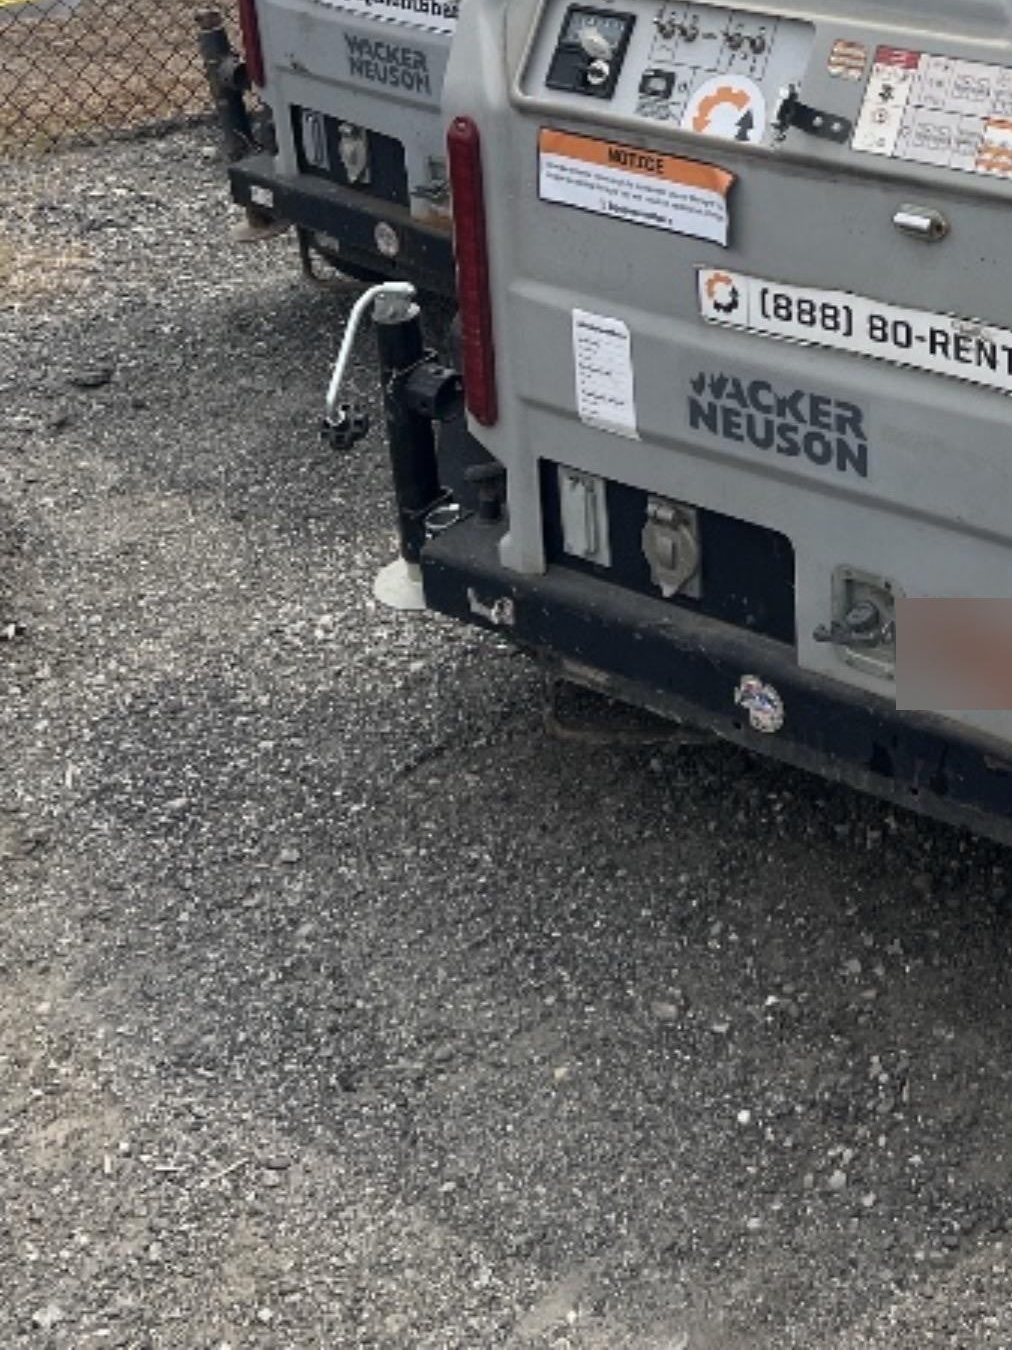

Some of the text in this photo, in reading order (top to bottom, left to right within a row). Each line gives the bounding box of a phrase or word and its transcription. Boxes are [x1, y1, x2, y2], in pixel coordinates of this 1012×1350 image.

[344, 33, 429, 73] WACKER
[349, 56, 433, 96] NEUSON
[607, 147, 666, 175] NOTICE
[759, 287, 853, 337] (888)
[689, 371, 867, 442] WACKER
[688, 396, 868, 479] NEUSON
